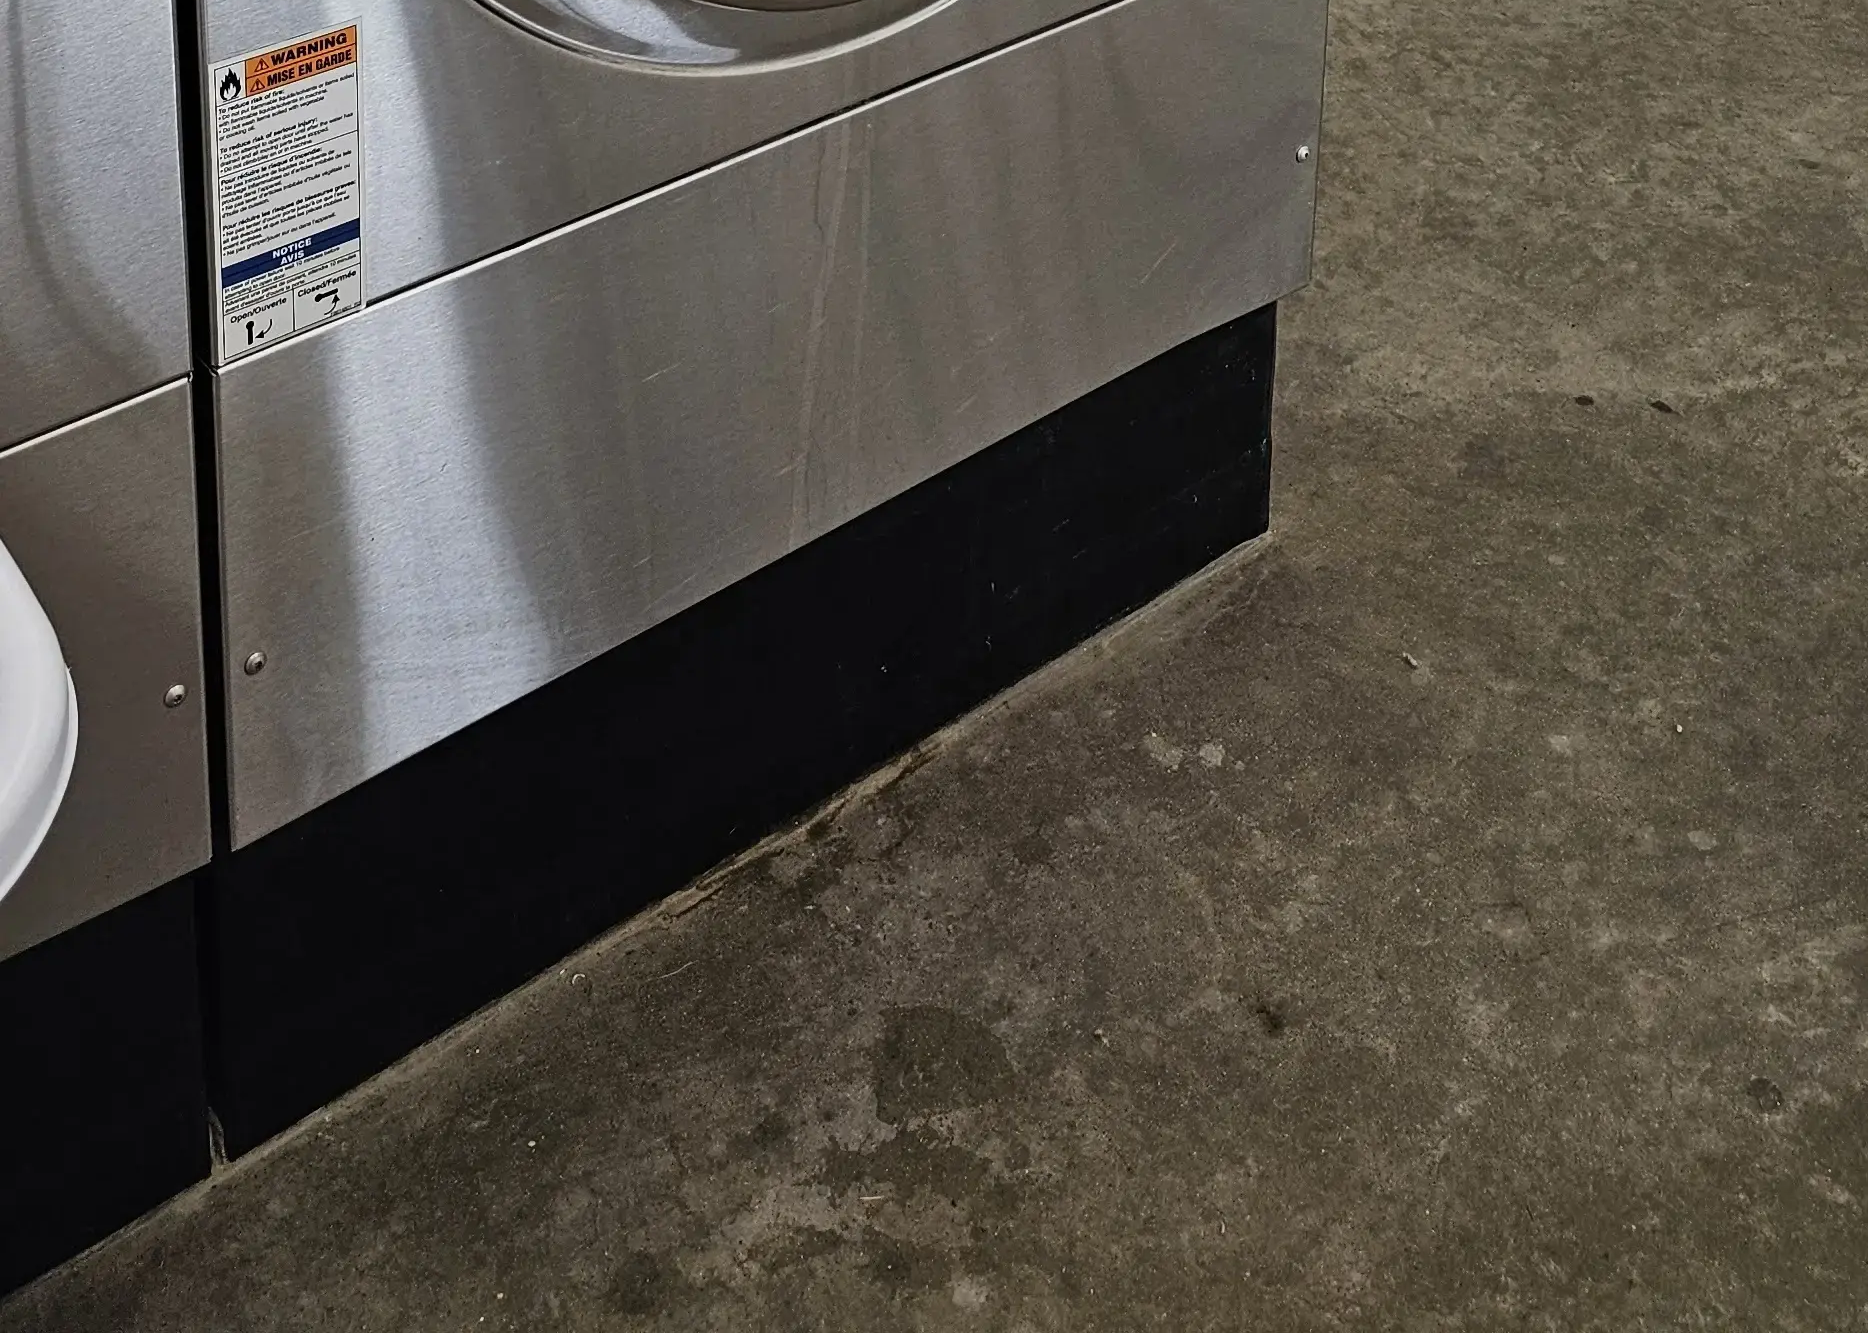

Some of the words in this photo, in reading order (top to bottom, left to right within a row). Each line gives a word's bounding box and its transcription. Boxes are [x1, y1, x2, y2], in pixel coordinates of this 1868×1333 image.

[270, 32, 347, 66] WARNING
[267, 67, 294, 85] MISE
[298, 62, 312, 75] EN
[315, 49, 351, 70] GARDE
[272, 238, 311, 257] NOTICE
[279, 250, 304, 264] AVIS
[297, 269, 356, 298] Closed/Fermée
[230, 296, 286, 324] Open/Ouverte
